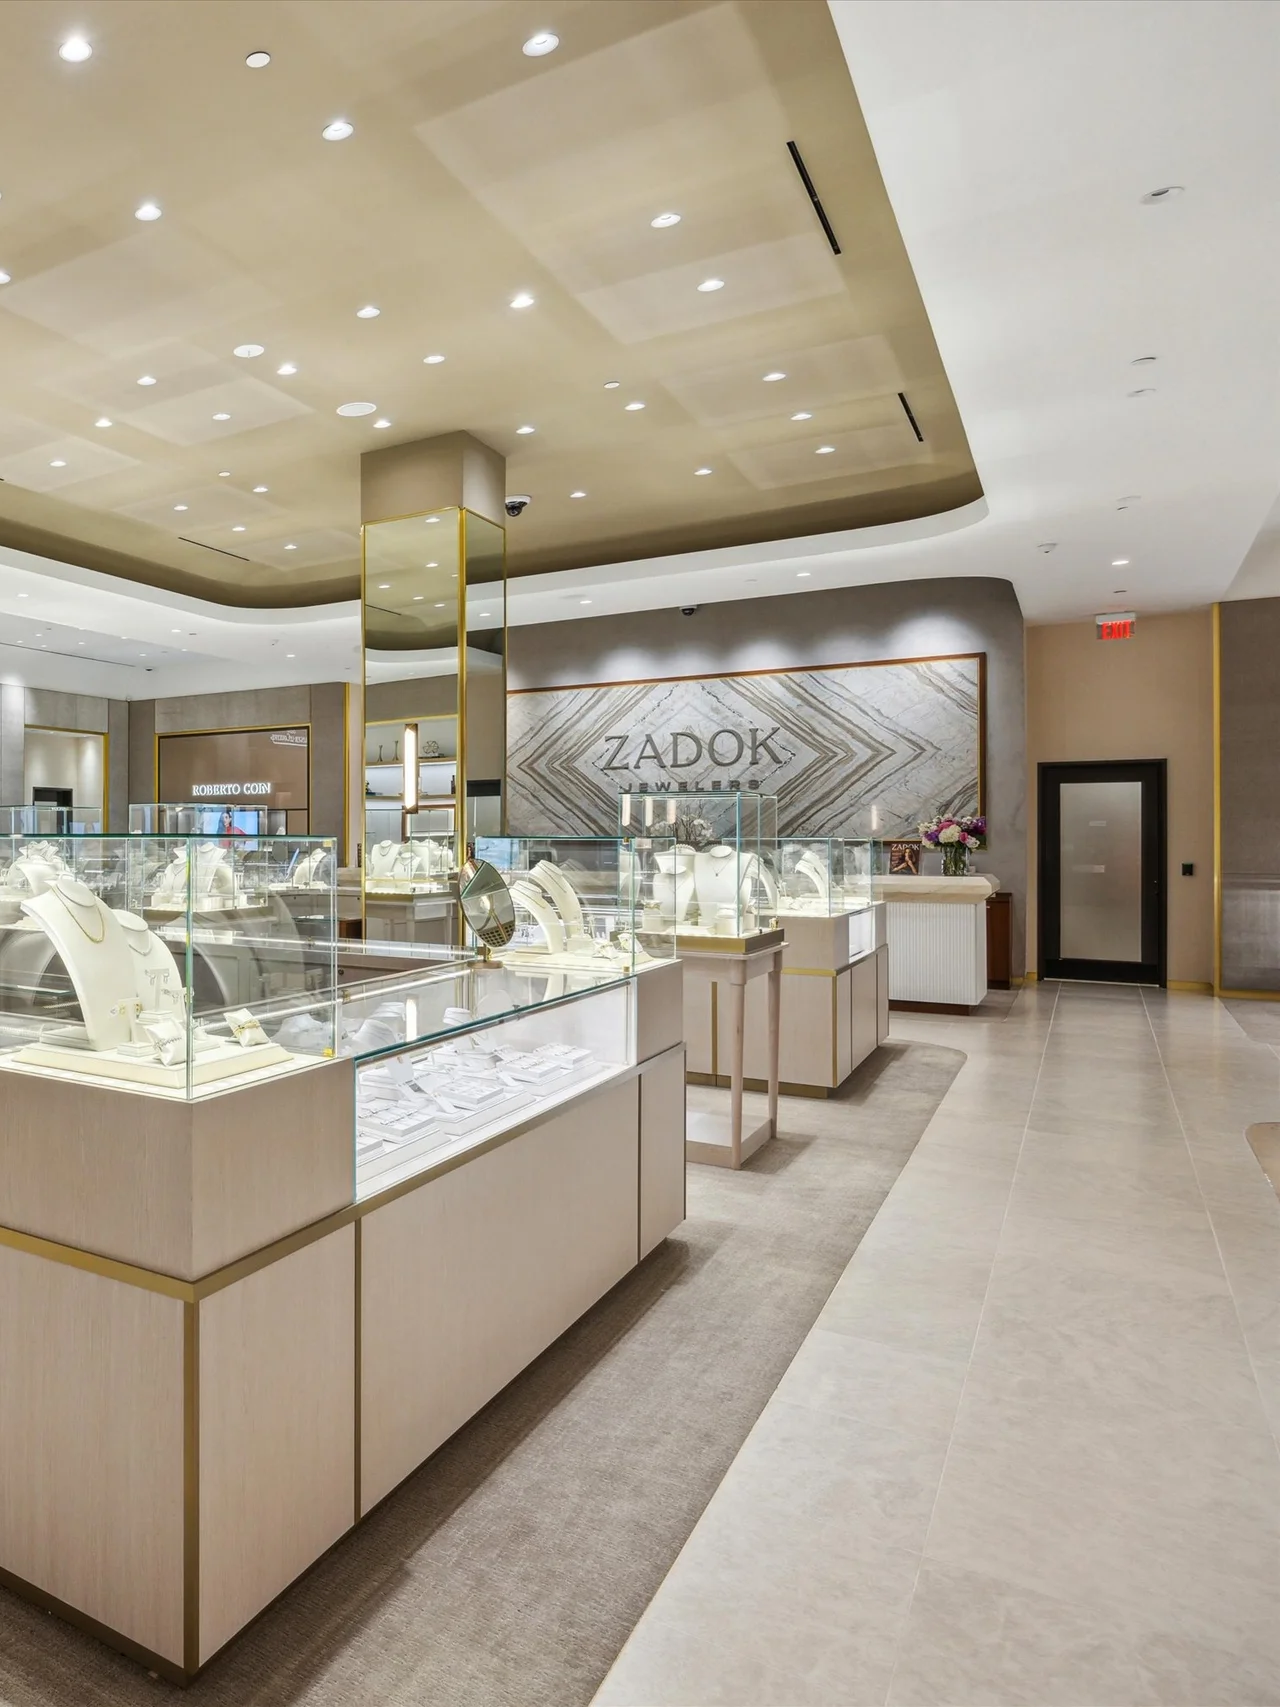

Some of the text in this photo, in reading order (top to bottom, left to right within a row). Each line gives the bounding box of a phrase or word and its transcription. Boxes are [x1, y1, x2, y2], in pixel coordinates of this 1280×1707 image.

[1101, 620, 1131, 640] EXIT
[603, 727, 783, 770] ZADOK
[192, 782, 271, 796] ROBERTO COIN
[623, 779, 761, 793] JEWELERS
